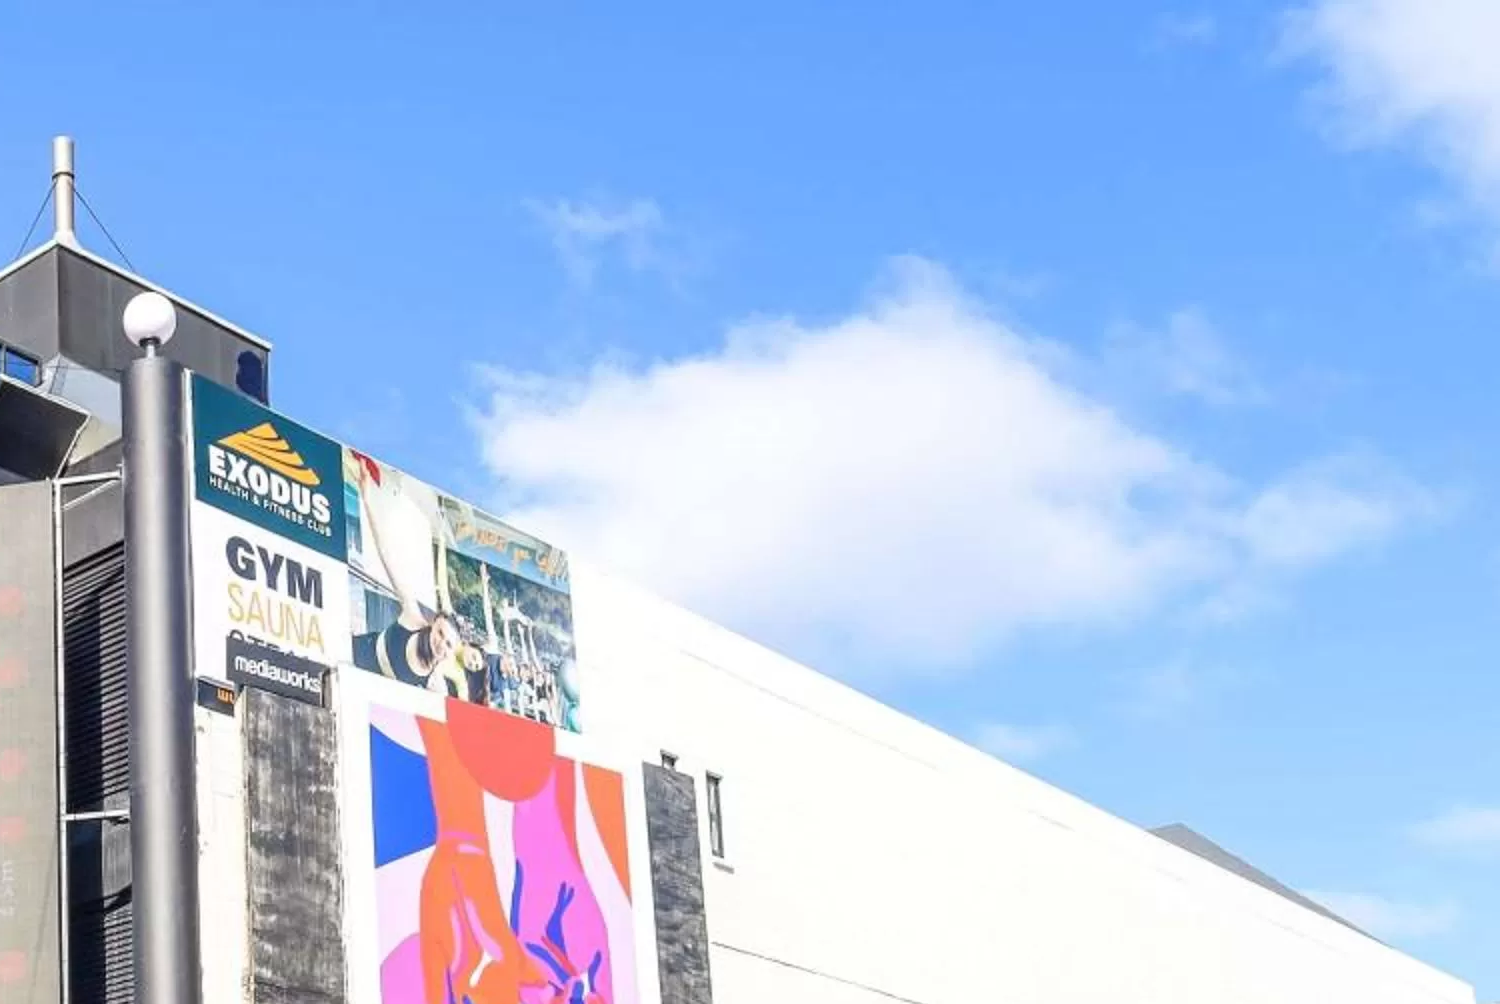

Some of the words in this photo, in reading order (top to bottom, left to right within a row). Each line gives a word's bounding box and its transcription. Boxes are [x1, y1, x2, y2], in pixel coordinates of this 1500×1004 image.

[208, 444, 331, 524] EXODUS
[209, 475, 249, 501] HEALTH
[307, 519, 332, 537] CLUB
[225, 535, 324, 610] GYM
[227, 580, 326, 655] SAUNA
[234, 655, 323, 693] mediaworks
